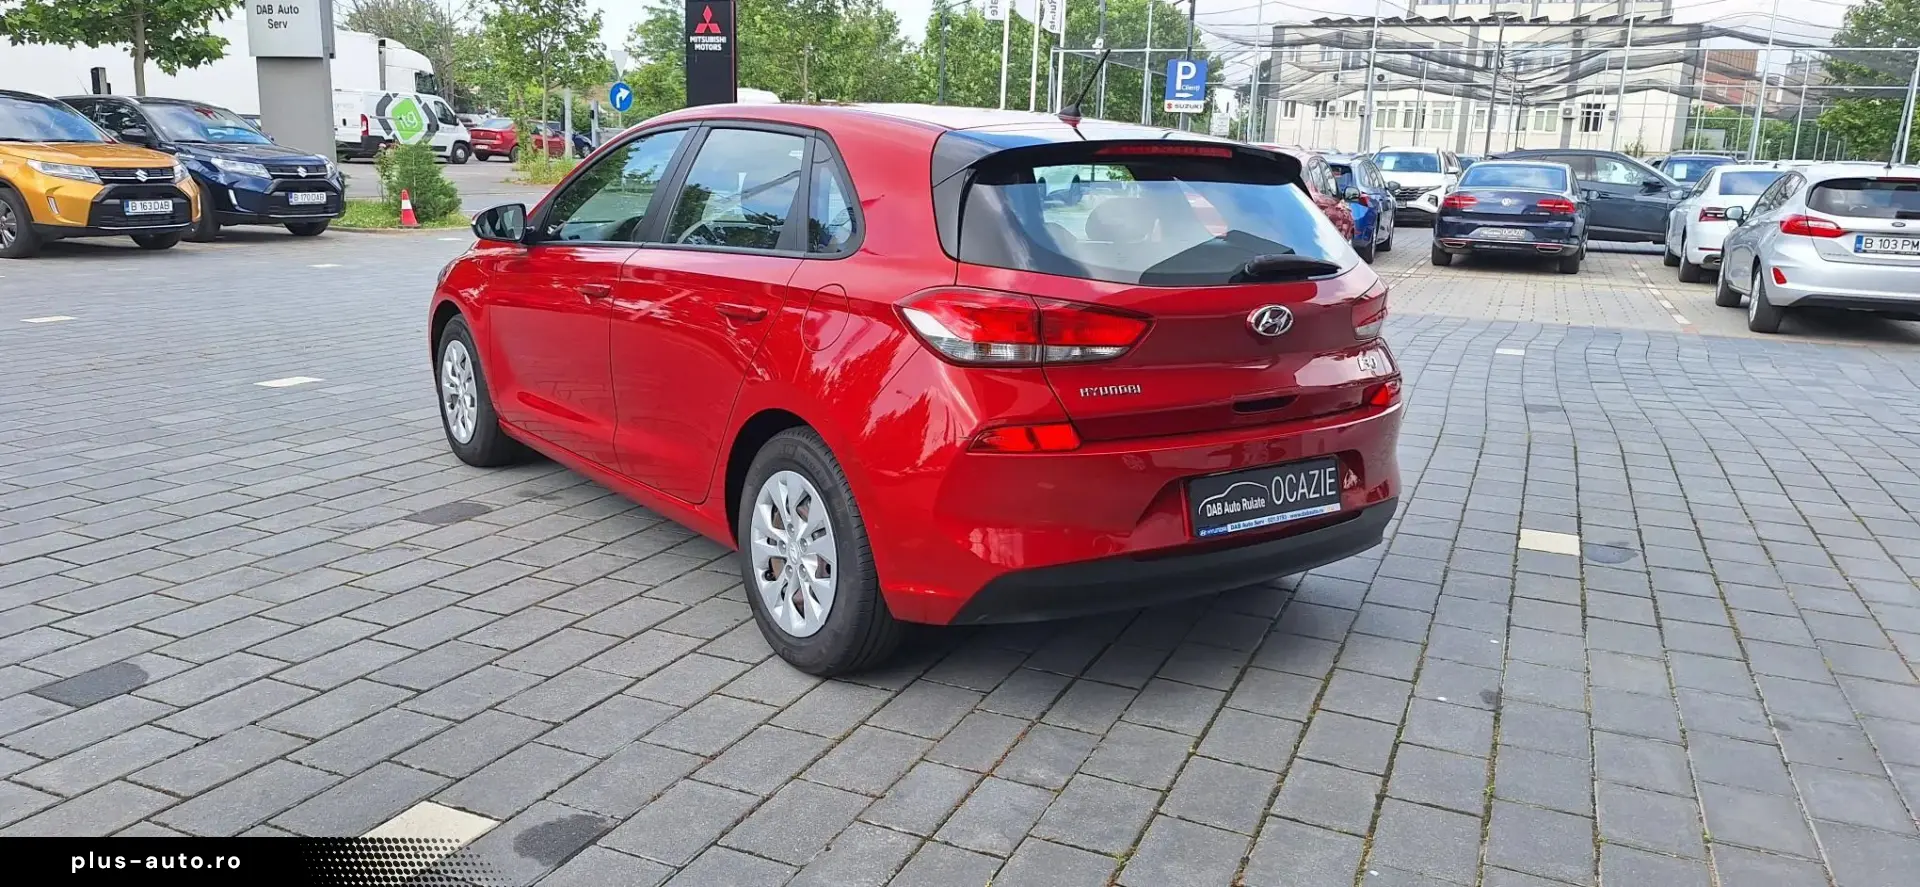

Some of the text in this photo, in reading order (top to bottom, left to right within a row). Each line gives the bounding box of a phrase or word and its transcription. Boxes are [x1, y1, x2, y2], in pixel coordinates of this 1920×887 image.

[256, 5, 299, 15] DAB Auto
[267, 18, 288, 29] Serv
[690, 35, 727, 43] MITSUBISHI
[694, 43, 722, 51] MOTORS
[1175, 61, 1197, 91] P
[293, 194, 299, 202] B
[131, 201, 170, 211] B 163 DAB
[1864, 238, 1920, 250] B 103 PM
[1079, 384, 1141, 397] HYUNDAI
[1271, 467, 1336, 505] OCAZIE
[1206, 496, 1266, 517] DAB Auto Rulate
